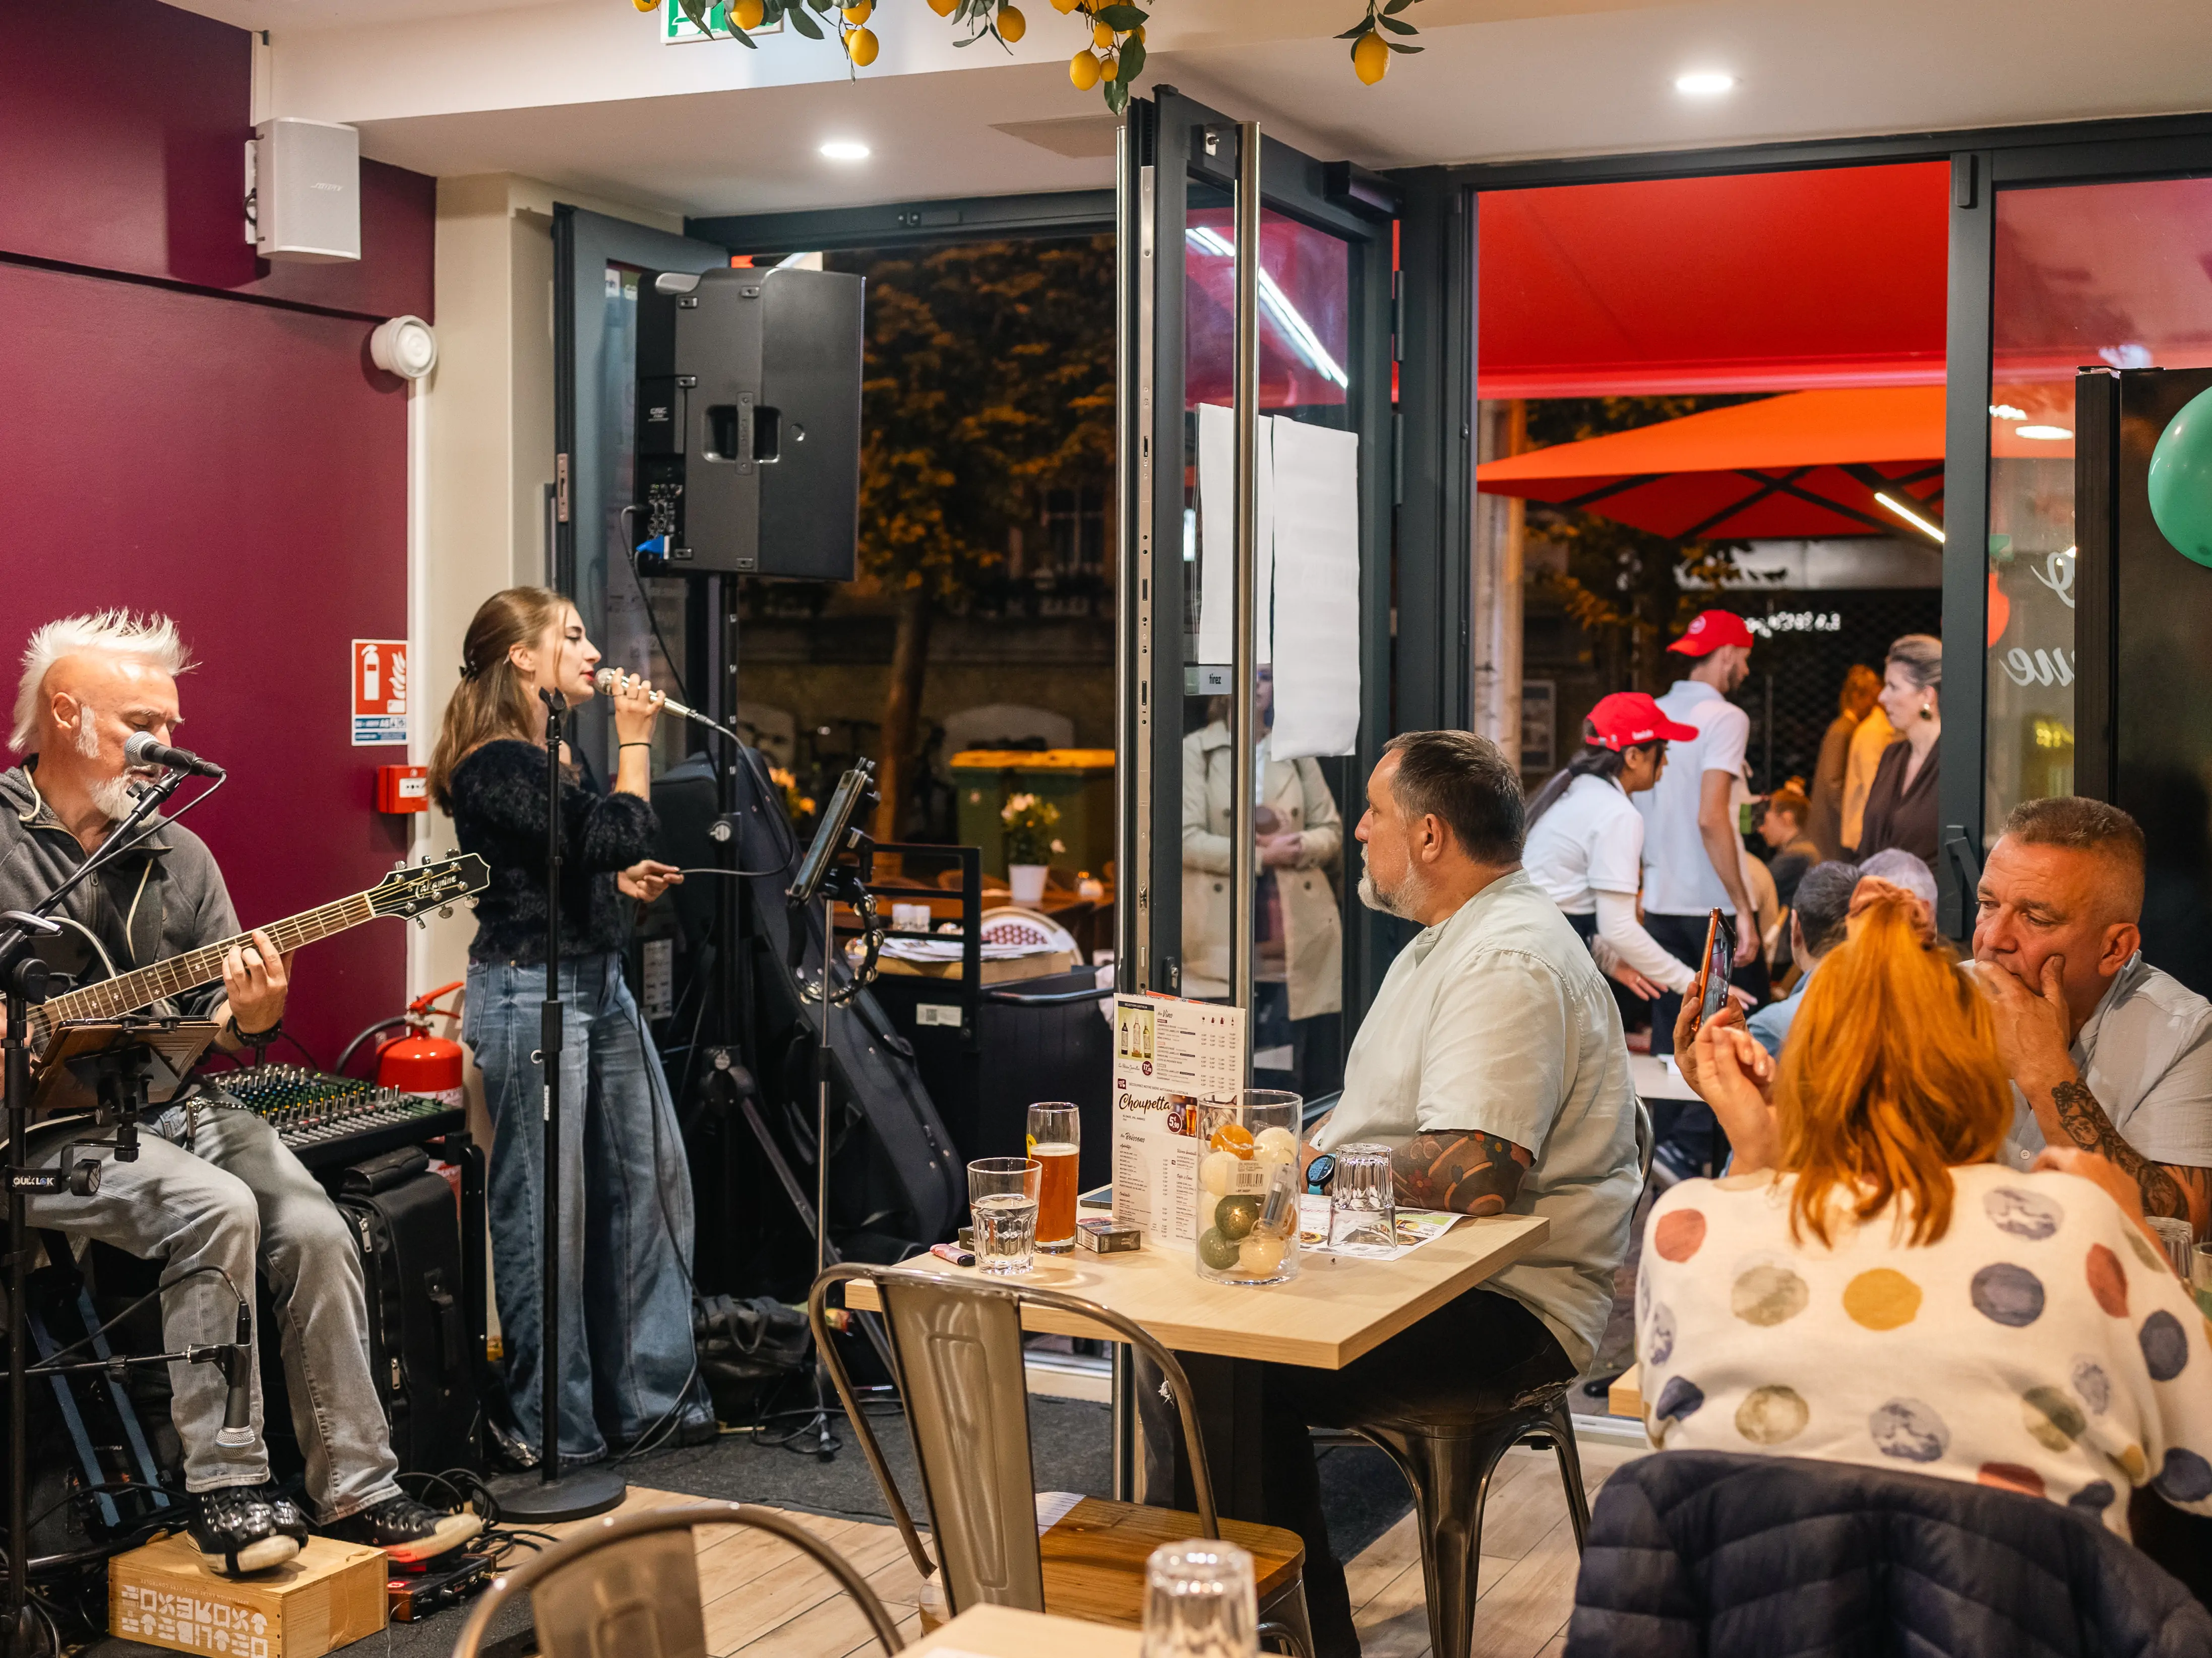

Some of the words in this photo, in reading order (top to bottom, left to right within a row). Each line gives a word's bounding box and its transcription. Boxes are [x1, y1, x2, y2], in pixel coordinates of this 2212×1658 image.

[1209, 673, 1221, 684] tirez
[407, 875, 457, 900] Takamine
[1119, 1093, 1172, 1115] Choupetta
